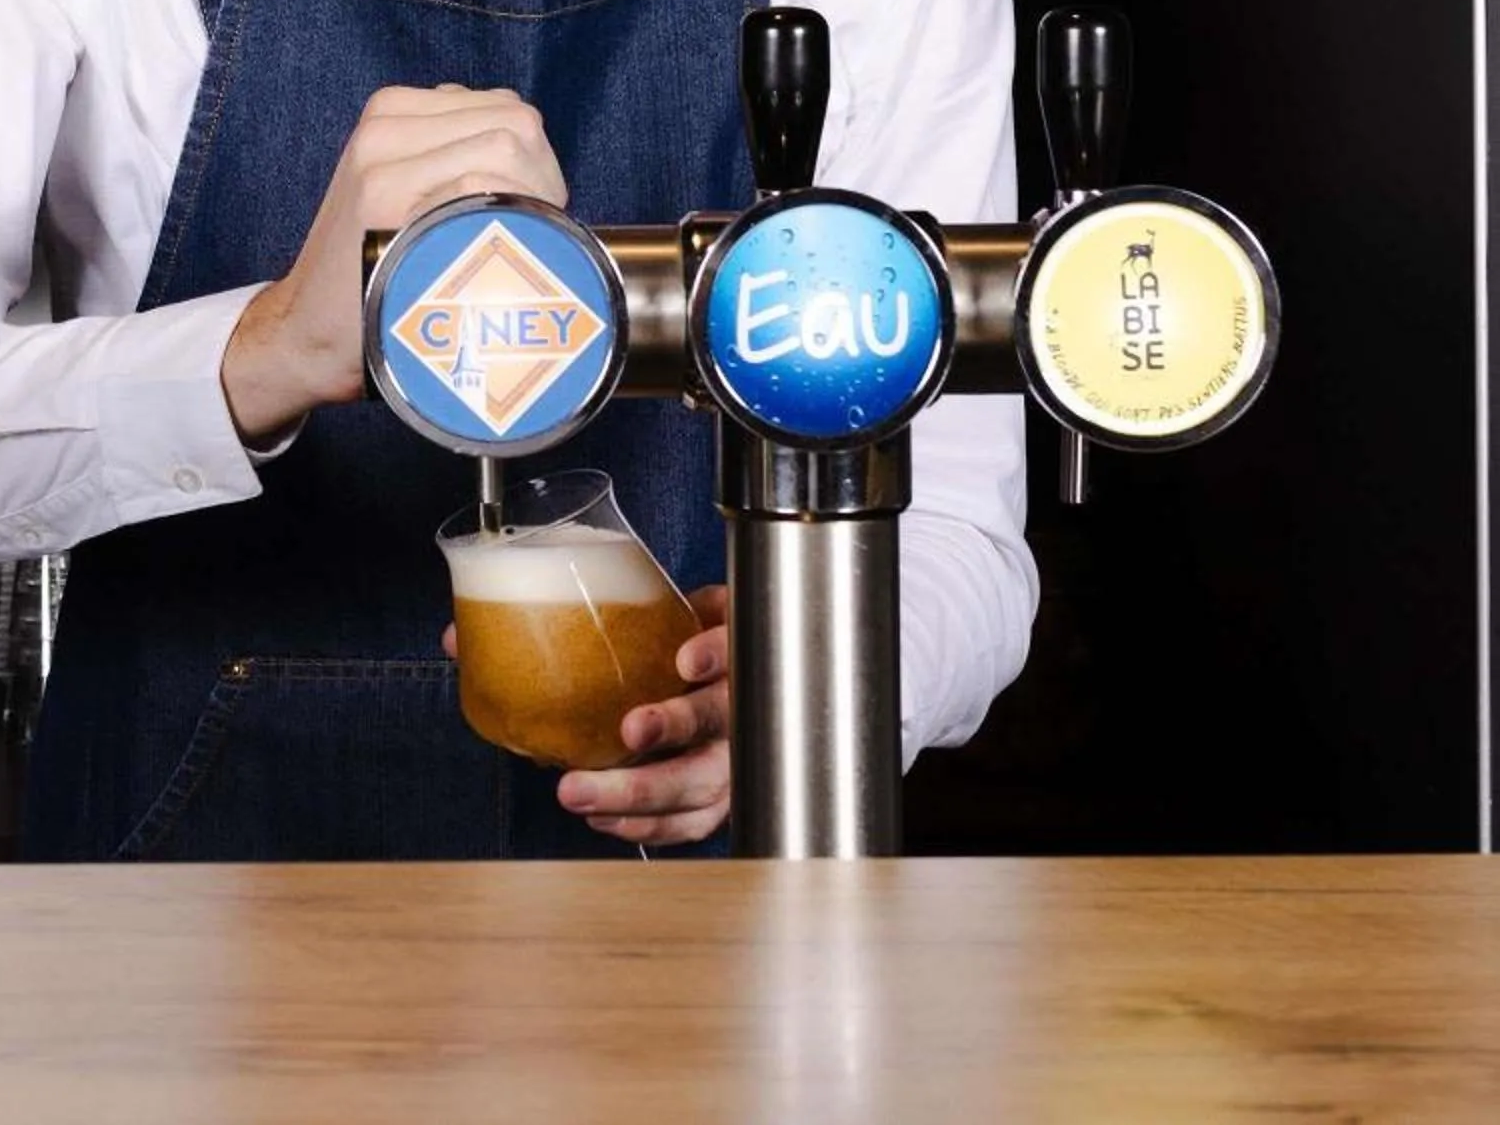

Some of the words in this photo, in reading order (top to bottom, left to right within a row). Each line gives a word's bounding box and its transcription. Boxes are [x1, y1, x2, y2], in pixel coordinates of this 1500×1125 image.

[1121, 272, 1160, 300] LA
[736, 270, 909, 364] Eau
[1122, 304, 1162, 335] BI
[1121, 340, 1166, 372] SE
